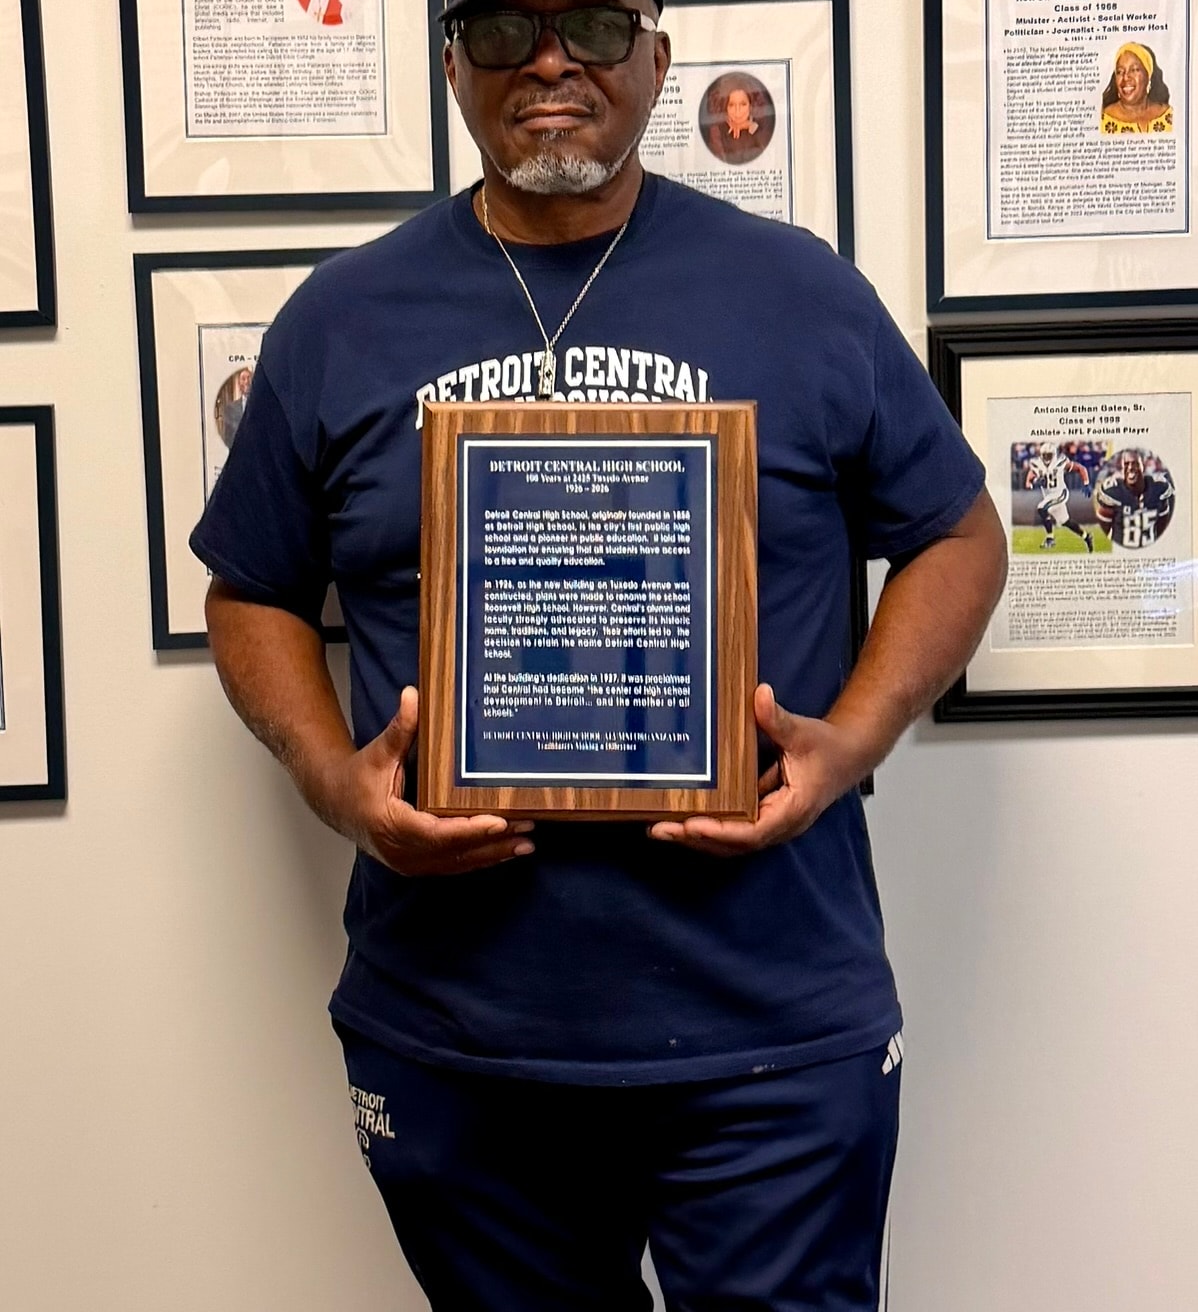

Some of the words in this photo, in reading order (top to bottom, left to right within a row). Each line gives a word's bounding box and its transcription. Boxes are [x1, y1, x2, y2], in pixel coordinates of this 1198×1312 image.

[1054, 4, 1080, 12] Class
[1082, 3, 1092, 11] of
[1016, 17, 1050, 25] Minister
[1098, 14, 1124, 22] Social
[1004, 28, 1044, 36] Politician
[1052, 26, 1094, 34] Journalist
[1102, 25, 1119, 33] Talk
[1123, 24, 1146, 32] Show
[228, 354, 245, 362] CPA
[564, 345, 714, 402] CENTRAL
[1034, 406, 1069, 414] Antonio
[1072, 405, 1098, 413] Ethan
[1101, 404, 1130, 412] Gates,
[1059, 417, 1084, 425] Class
[1087, 416, 1096, 424] of
[1123, 427, 1149, 435] Player
[490, 461, 542, 472] DETROIT
[544, 460, 600, 472] CENTRAL
[603, 460, 633, 472] HIGH
[636, 460, 685, 472] SCHOOL
[485, 510, 510, 520] Detroit
[512, 510, 541, 520] Central
[542, 510, 560, 521] High
[592, 510, 627, 521] originally
[628, 510, 662, 520] founded
[663, 511, 671, 520] in
[485, 523, 494, 531] as
[497, 521, 524, 531] Detroit
[526, 522, 545, 533] High
[579, 522, 586, 531] is
[588, 522, 601, 531] the
[628, 522, 642, 532] first
[644, 522, 670, 532] public
[673, 522, 691, 533] high
[485, 533, 511, 545] school
[513, 533, 529, 543] and
[530, 534, 536, 543] a
[538, 533, 569, 544] pioneer
[570, 533, 578, 542] in
[579, 533, 604, 544] public
[660, 533, 676, 543] laid
[677, 532, 691, 543] the
[484, 545, 527, 554] foundation
[528, 544, 539, 554] for
[541, 545, 575, 556] ensuring
[576, 545, 592, 554] that
[594, 544, 604, 554] all
[605, 545, 638, 554] students
[640, 545, 660, 554] have
[662, 546, 691, 555] access
[485, 556, 493, 565] to
[494, 557, 500, 566] a
[501, 556, 517, 565] free
[518, 556, 534, 566] and
[536, 556, 562, 567] quality
[484, 637, 520, 647] decision
[523, 637, 532, 647] to
[534, 637, 559, 647] retain
[561, 638, 575, 647] the
[578, 639, 602, 647] name
[605, 637, 634, 648] Detroit
[636, 638, 668, 648] Central
[671, 638, 690, 649] High
[350, 1084, 386, 1111] ETROIT
[355, 1105, 395, 1139] TRAL
